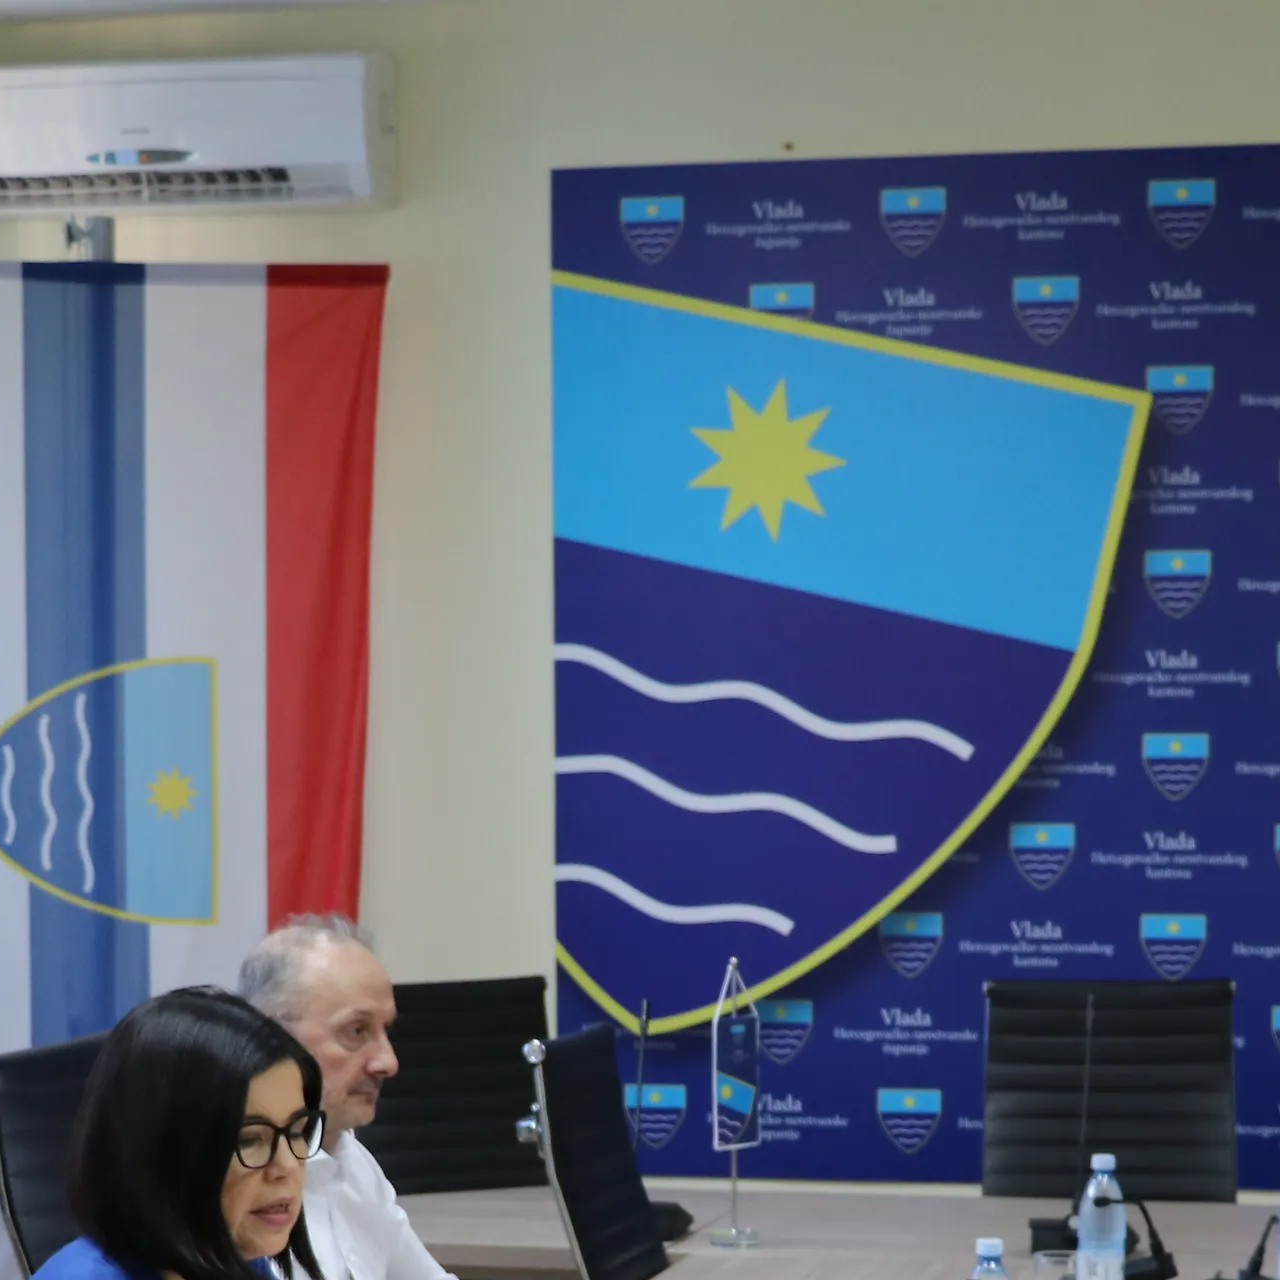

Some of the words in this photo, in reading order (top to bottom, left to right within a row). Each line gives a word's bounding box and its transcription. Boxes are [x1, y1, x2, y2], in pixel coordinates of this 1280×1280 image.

[752, 199, 804, 221] Vlada
[1014, 191, 1068, 212] Vlada
[883, 286, 936, 308] Vlada
[1148, 280, 1203, 302] Vlada
[1147, 465, 1201, 486] Vlada
[1145, 649, 1199, 670] Vlada
[1143, 831, 1197, 851] Vlada
[1010, 920, 1063, 940] Vlada
[880, 1007, 932, 1027] Vlada
